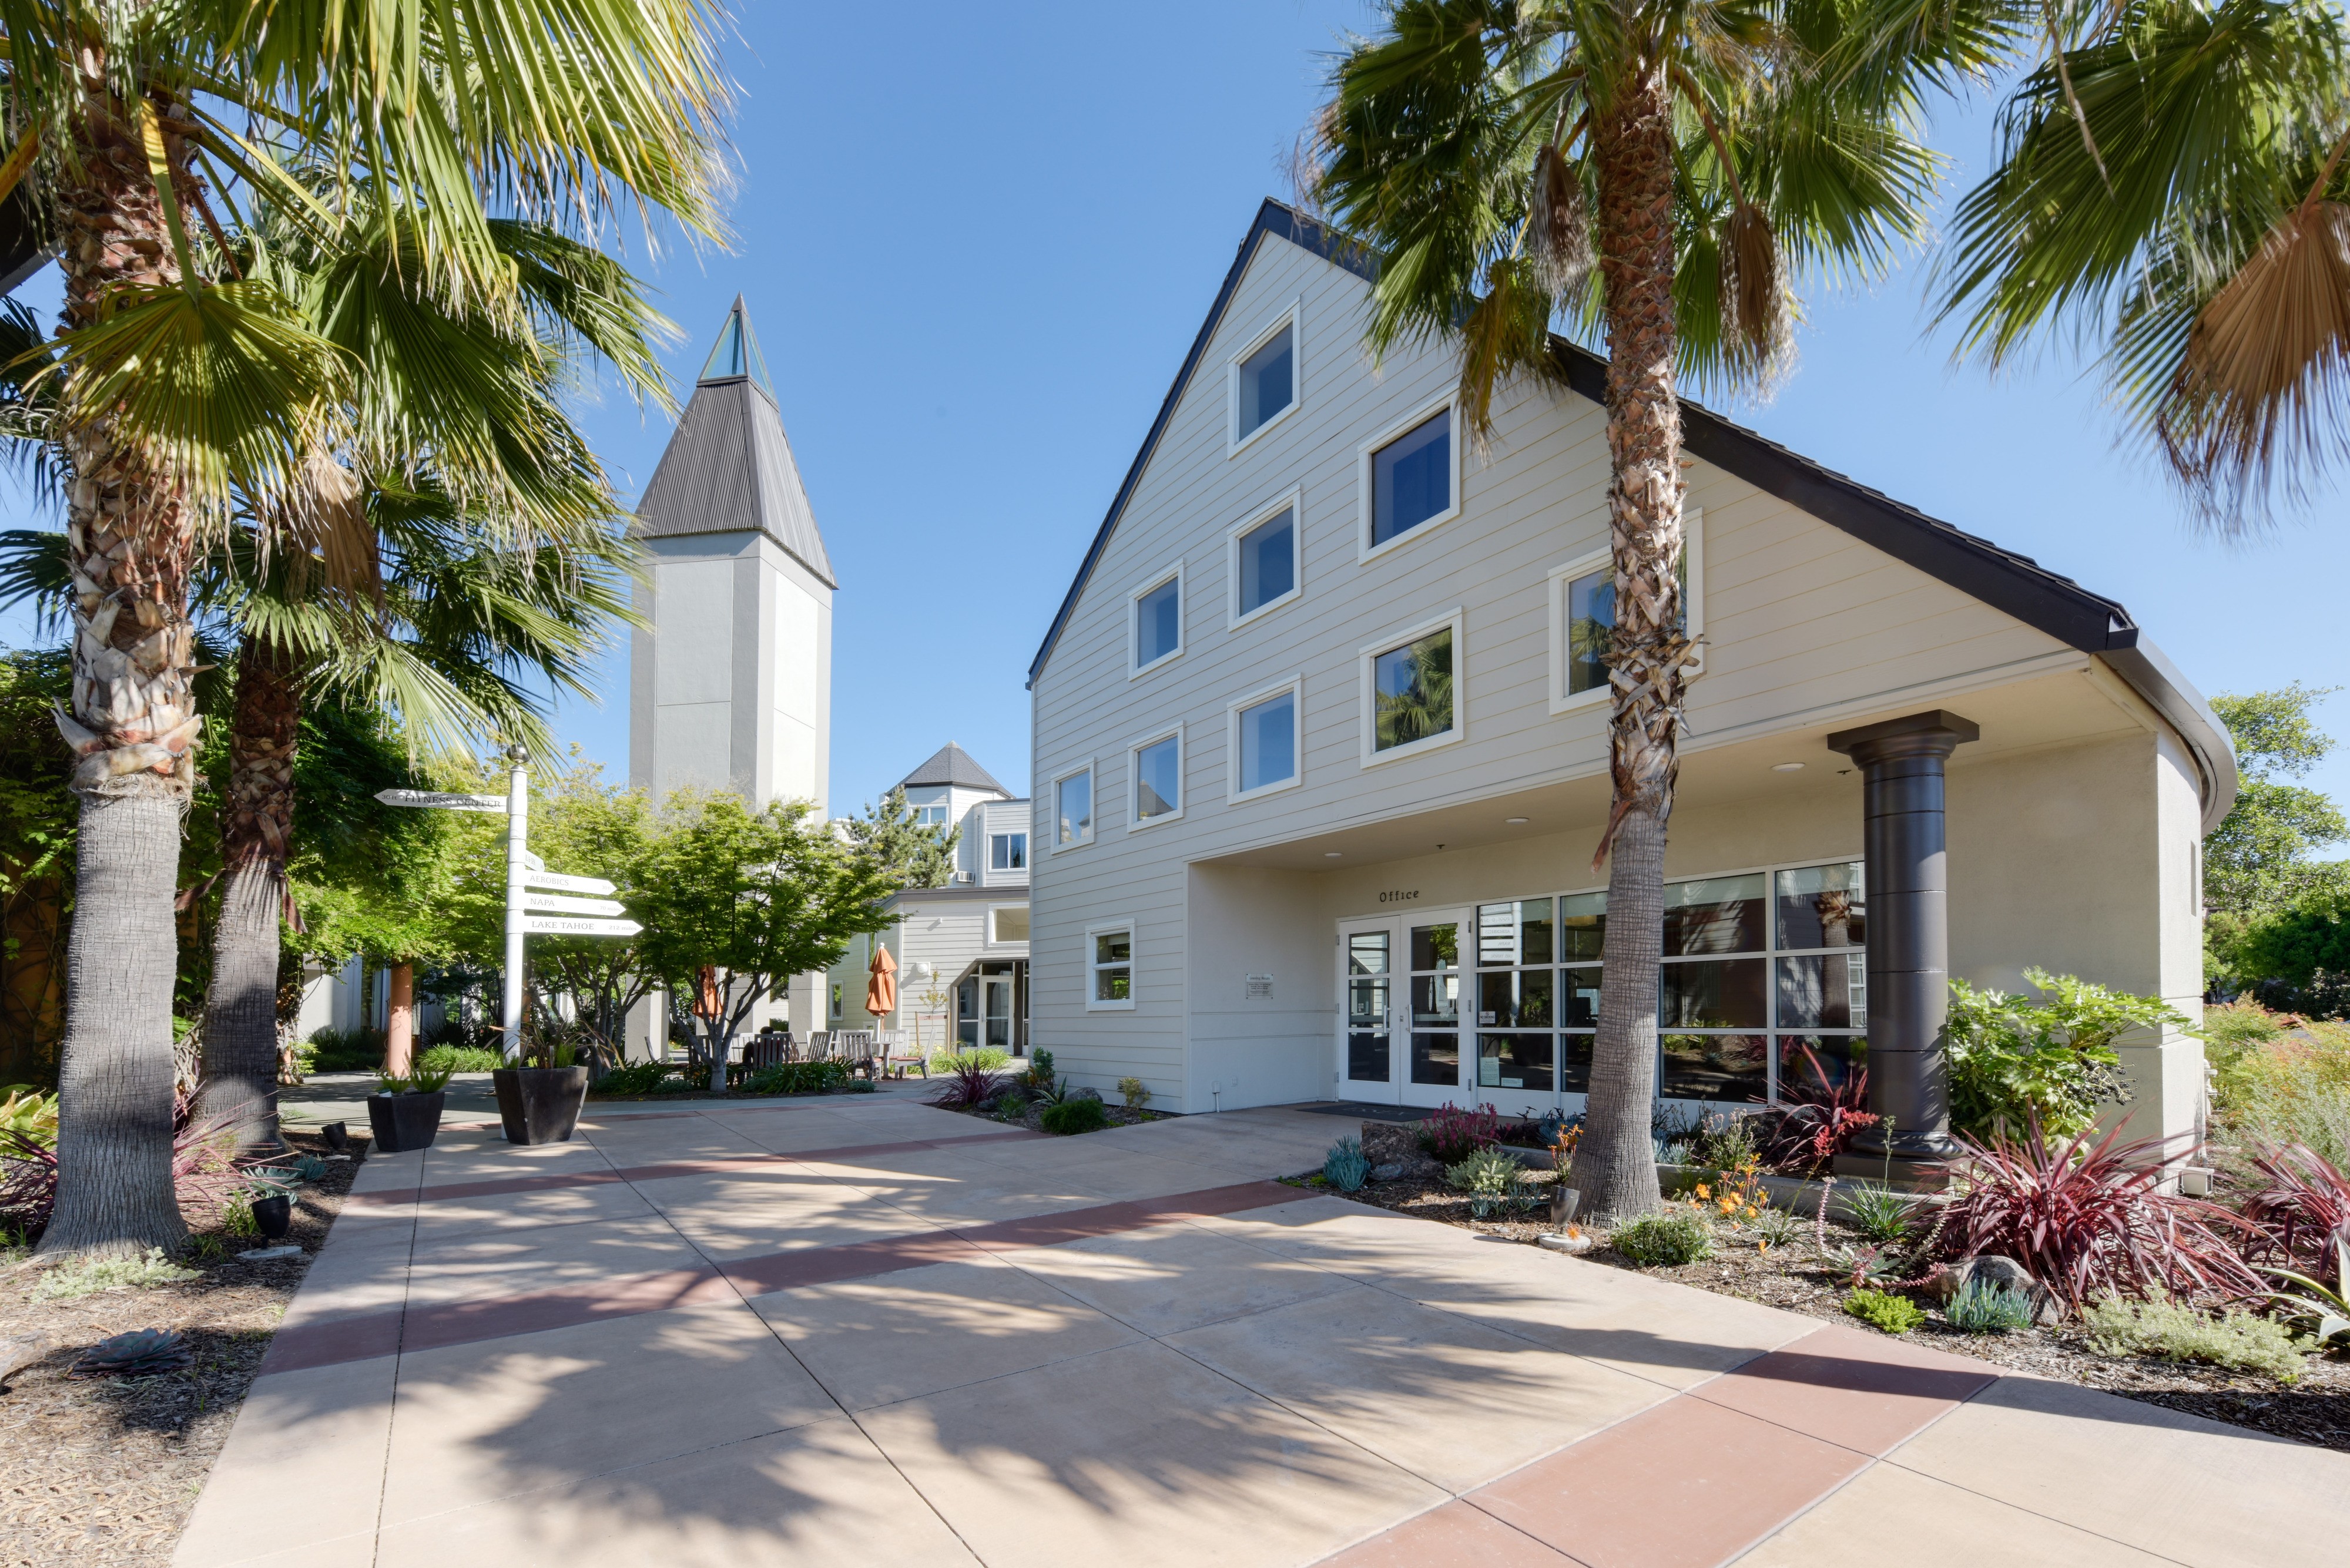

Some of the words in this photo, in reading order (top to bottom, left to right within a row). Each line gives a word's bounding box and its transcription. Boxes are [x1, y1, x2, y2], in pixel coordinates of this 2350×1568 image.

[404, 795, 452, 804] FITNESS
[457, 798, 501, 807] CENTER
[529, 875, 569, 886] AEROBICS
[1379, 890, 1419, 902] Office
[530, 898, 555, 906] NAPA
[561, 922, 594, 930] TAHOE
